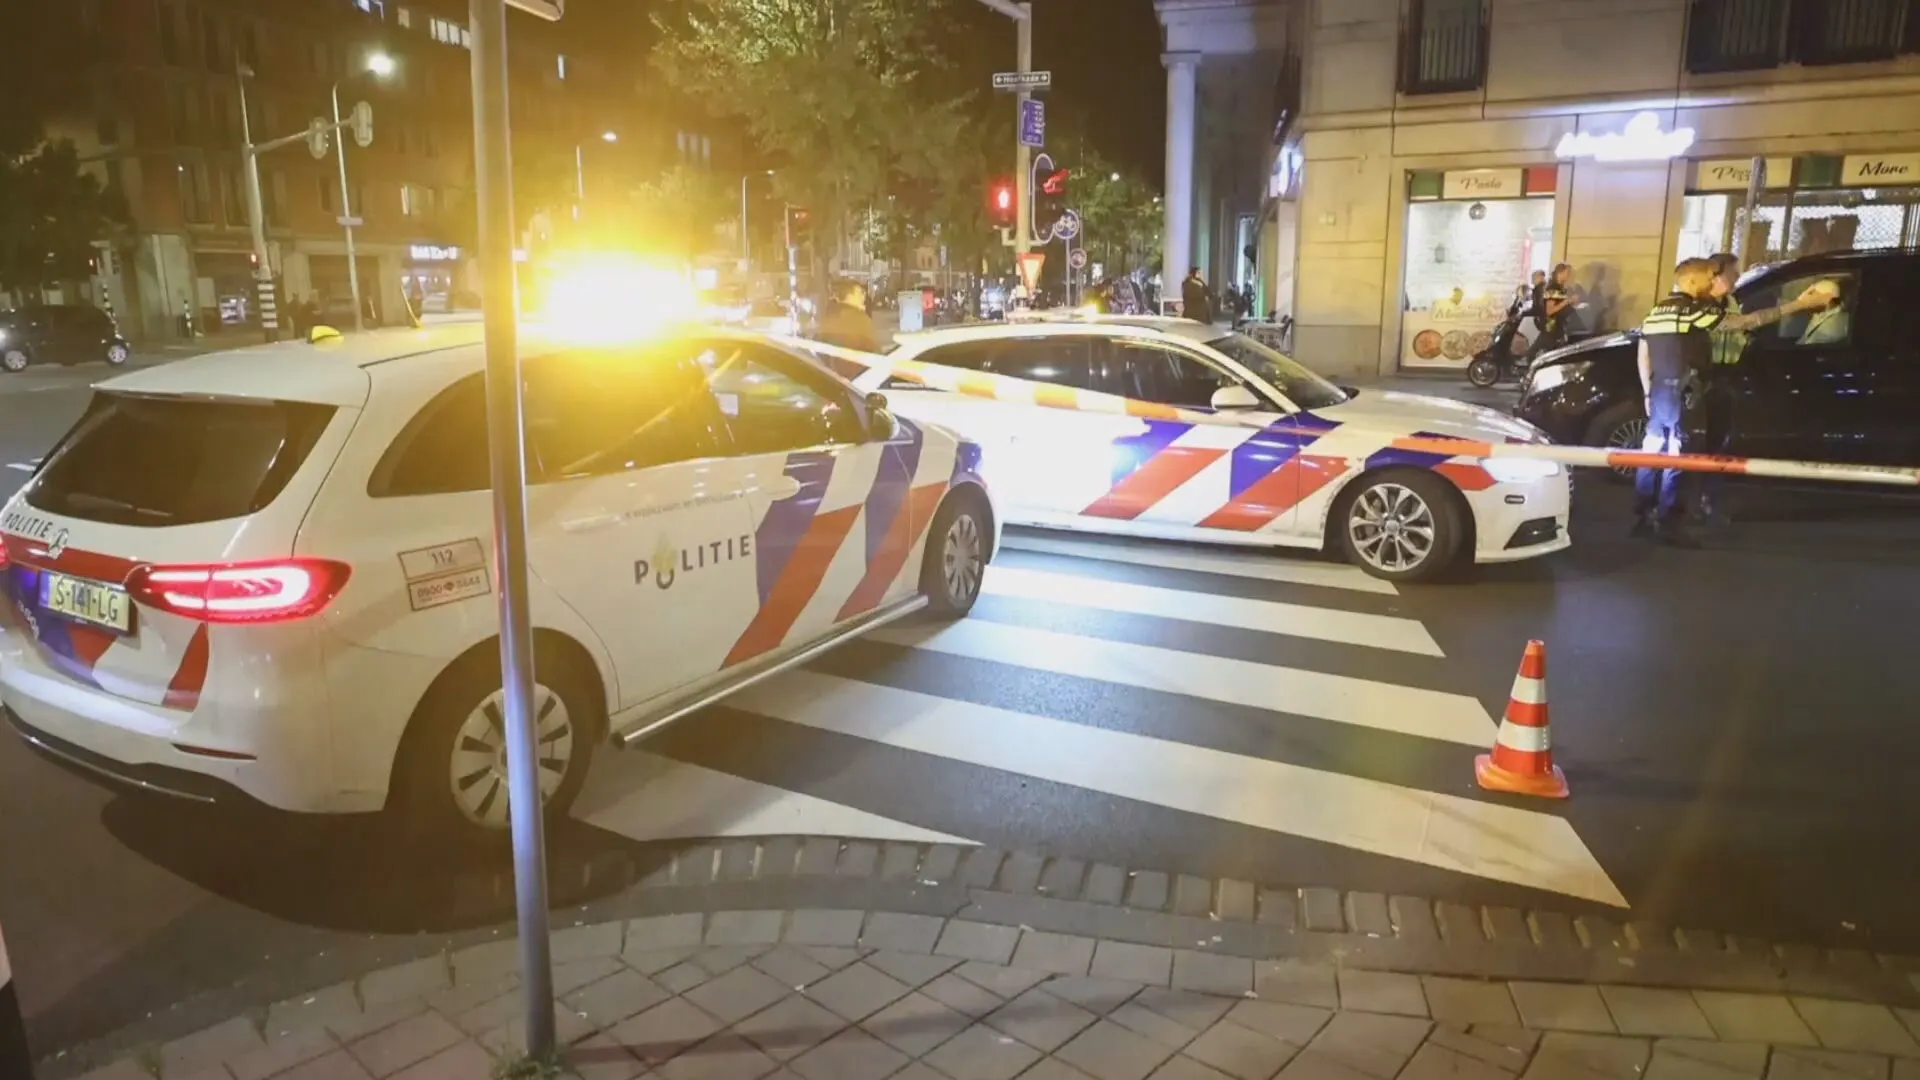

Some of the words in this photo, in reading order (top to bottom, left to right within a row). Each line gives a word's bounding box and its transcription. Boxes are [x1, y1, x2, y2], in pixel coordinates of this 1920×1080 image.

[1858, 160, 1908, 176] More
[5, 513, 53, 538] POLITIE
[431, 549, 454, 565] 112
[633, 534, 751, 590] POLITIE
[55, 576, 118, 622] S-141-LG
